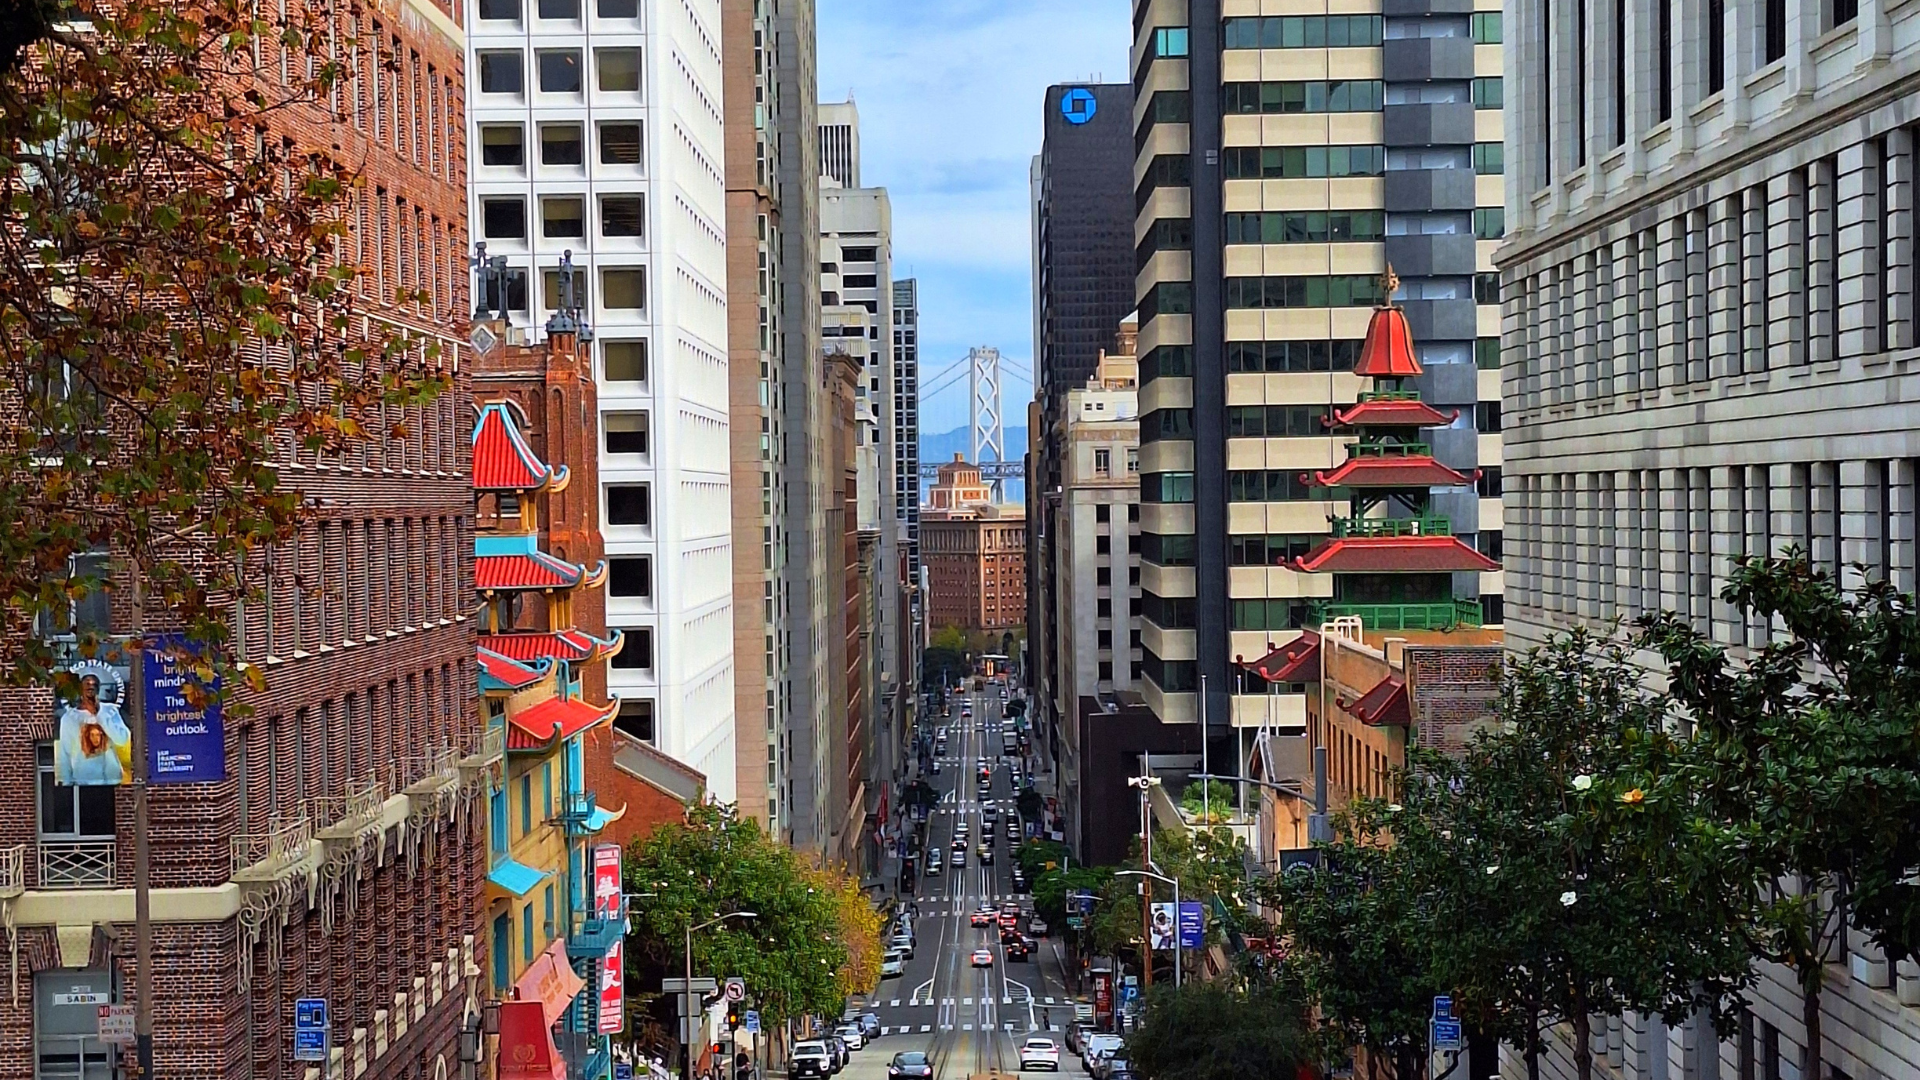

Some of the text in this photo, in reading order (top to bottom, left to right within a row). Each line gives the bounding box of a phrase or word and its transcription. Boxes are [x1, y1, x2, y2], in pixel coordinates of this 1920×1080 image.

[111, 671, 126, 708] UNIVER
[165, 696, 185, 707] The
[156, 709, 206, 723] brightest
[98, 1006, 109, 1016] NO
